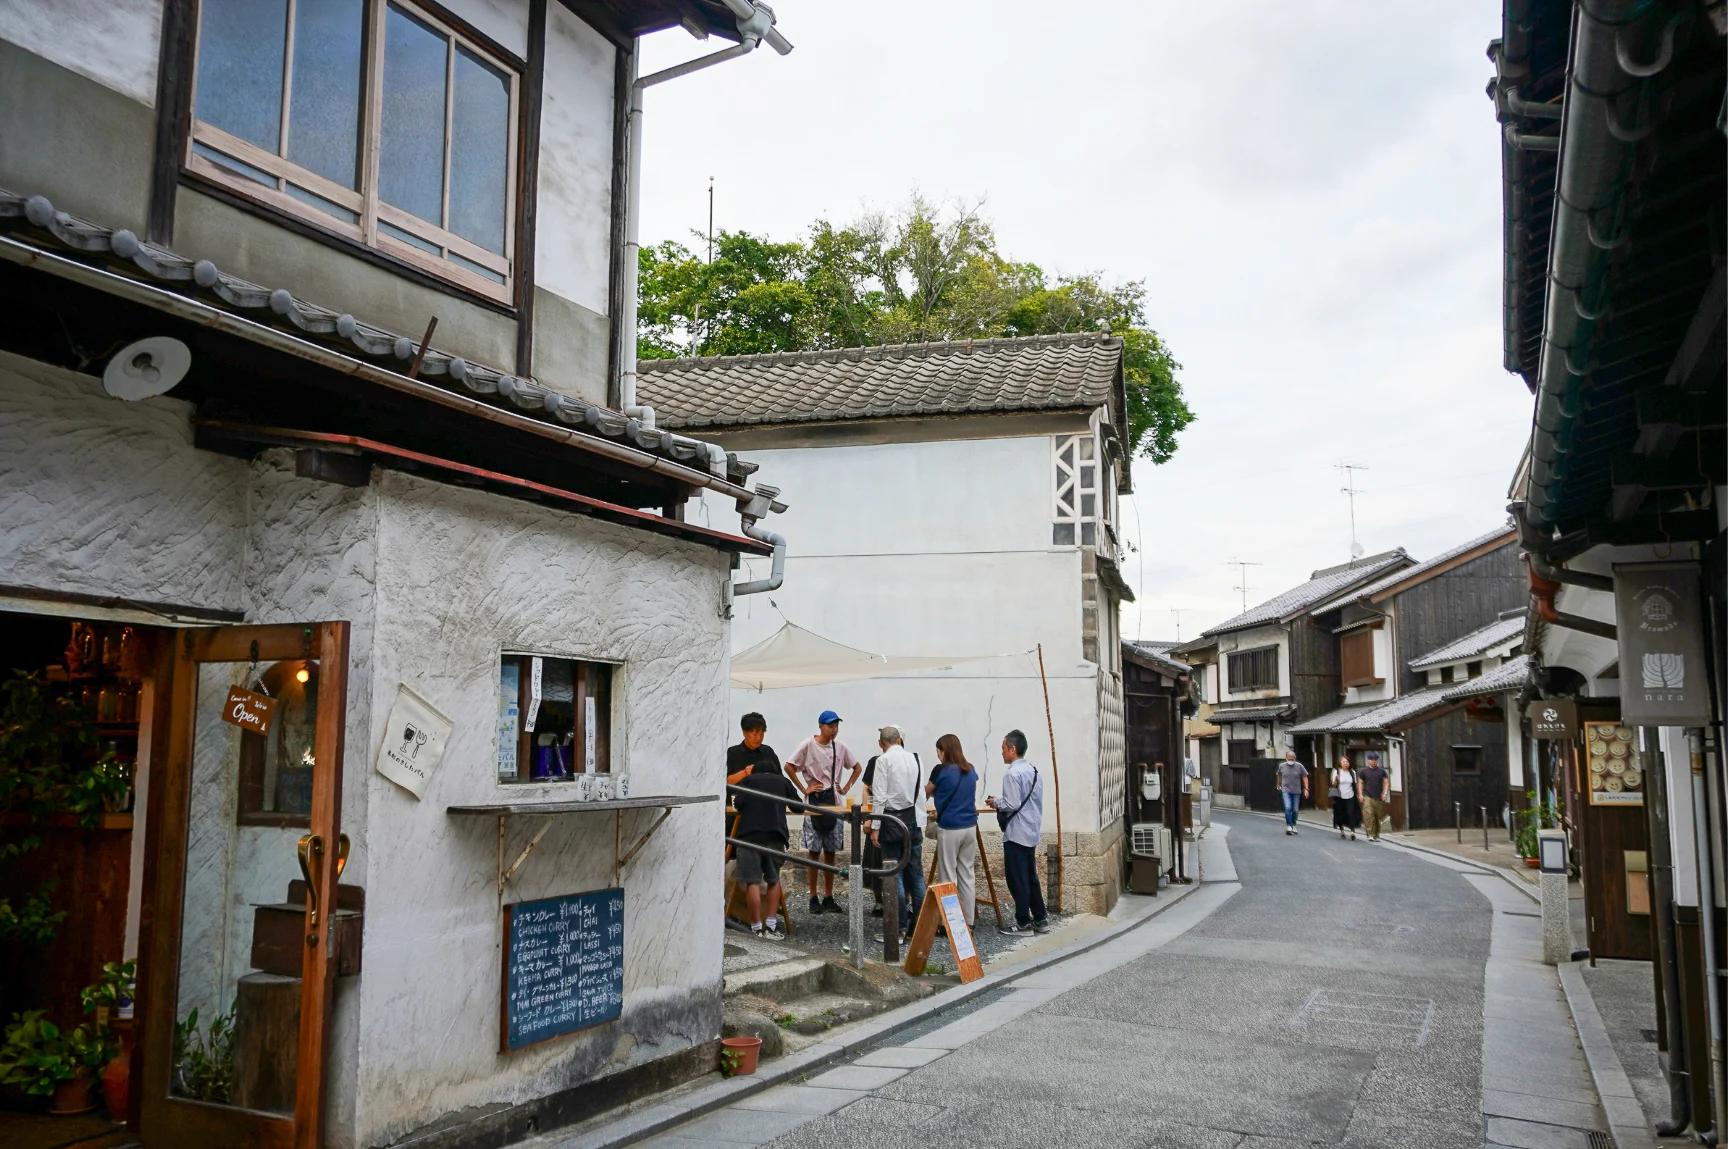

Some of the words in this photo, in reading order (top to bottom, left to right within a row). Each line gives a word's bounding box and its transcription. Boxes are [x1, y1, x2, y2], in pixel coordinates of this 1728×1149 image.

[1645, 693, 1685, 701] nara
[232, 703, 260, 724] Open
[518, 909, 556, 926] チキンカレー
[583, 917, 598, 928] CHAI
[518, 924, 547, 938] CHICKEN
[548, 919, 571, 933] CURRY
[518, 937, 548, 951] ナスカレー
[550, 943, 571, 956] CURRY
[583, 939, 600, 949] LASSI
[518, 973, 541, 987] KEEMA
[543, 966, 563, 979] CURRY
[597, 983, 613, 994] JUICE
[517, 999, 530, 1012] THAI
[531, 994, 554, 1006] GREEN
[555, 988, 572, 1000] CURRY
[553, 1011, 576, 1024] CURRY
[584, 1006, 607, 1020] 生ビール
